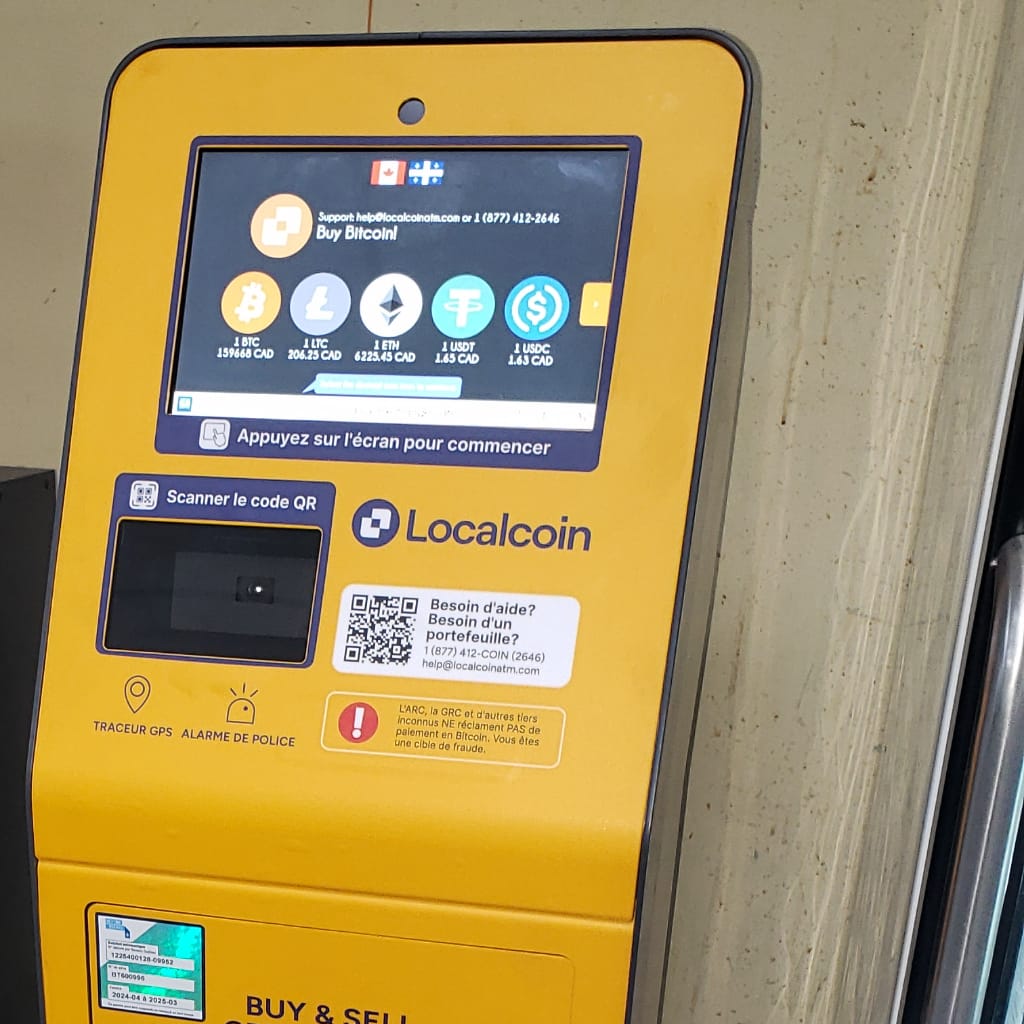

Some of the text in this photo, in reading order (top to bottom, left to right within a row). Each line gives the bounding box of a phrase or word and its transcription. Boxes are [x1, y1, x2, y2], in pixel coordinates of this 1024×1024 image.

[317, 211, 355, 224] Support:
[462, 214, 472, 223] or
[474, 213, 480, 223] 1
[482, 213, 510, 224] (877)
[512, 213, 560, 224] 412-2646
[316, 225, 398, 242] Buy Bitcoin!
[233, 337, 260, 347] 1 BTC
[303, 338, 328, 349] 1 LTC
[374, 340, 400, 350] 1 ETH
[441, 341, 476, 352] 1 USDT
[514, 343, 551, 355] 1 USDC
[254, 349, 274, 359] CAD
[321, 350, 342, 361] CAD
[394, 352, 416, 363] CAD
[458, 353, 480, 365] CAD
[531, 355, 554, 366] CAD
[237, 428, 551, 456] Appuyez sur l'écran pour commencer
[166, 489, 317, 511] Scanner le code QR
[406, 509, 592, 552] Localcoin
[430, 599, 536, 617] Besoin d'aide?
[428, 613, 512, 630] Besoin d'un
[426, 629, 520, 647] portefeuille?
[431, 647, 457, 658] (877)
[459, 648, 509, 661] 412-COIN
[511, 651, 546, 664] (2646)
[422, 659, 541, 676] help@localcoinatm.com
[399, 704, 538, 724] L'ARC, la GRC et d'autres tiers
[93, 720, 173, 737] TRACEUR GPS
[397, 715, 541, 735] inconnus NE réclament PAS de
[181, 728, 296, 748] ALARME DE POLICE
[395, 727, 540, 747] paiement en Bitcoin. Vous êtes
[394, 738, 486, 754] une cible de fraude.
[246, 995, 306, 1022] BUY
